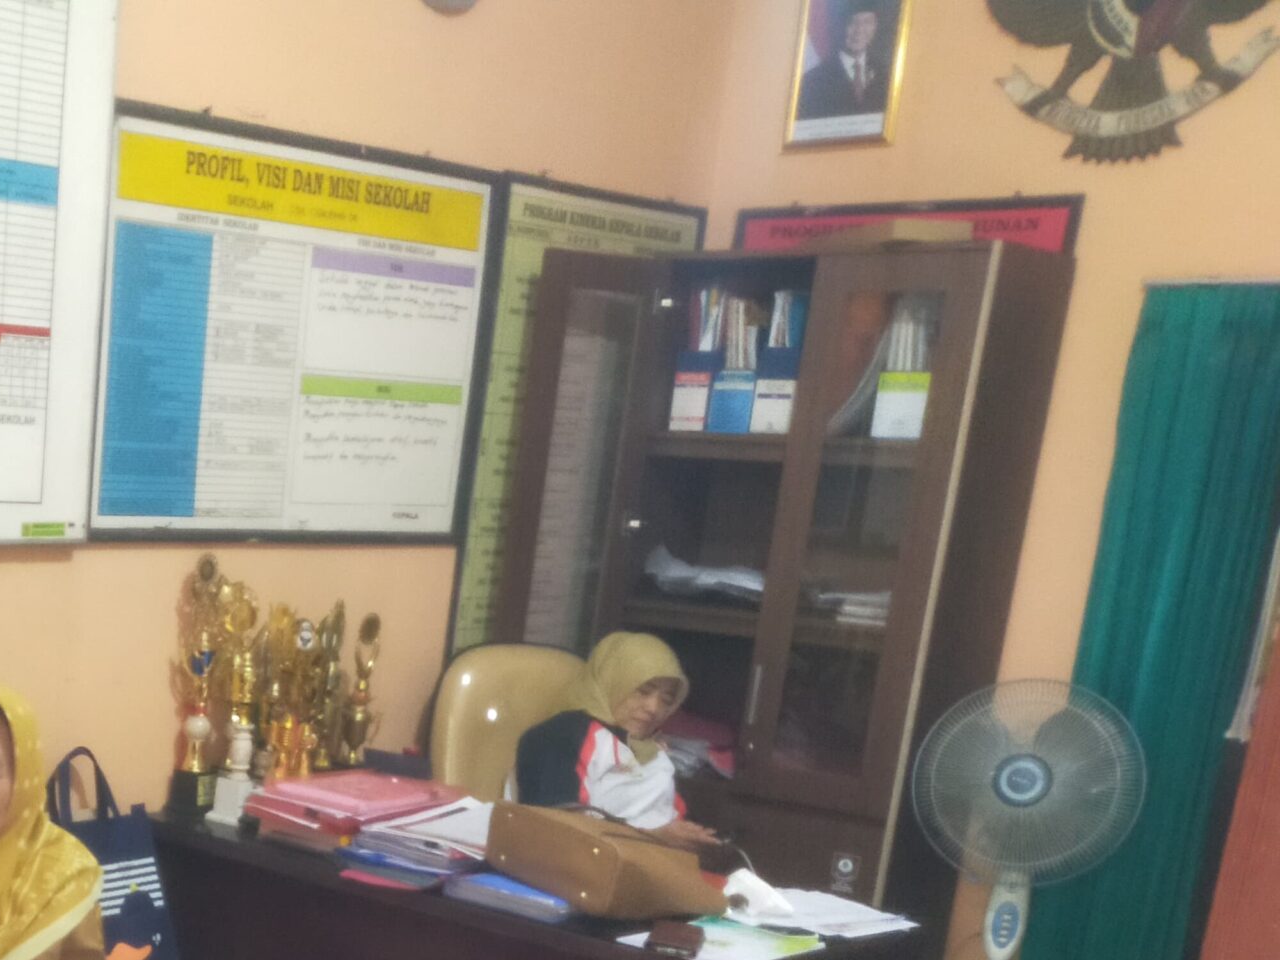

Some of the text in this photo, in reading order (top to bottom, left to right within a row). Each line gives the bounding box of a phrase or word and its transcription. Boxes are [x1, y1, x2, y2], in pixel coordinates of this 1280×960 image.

[186, 151, 249, 187] PROFIL,
[256, 161, 287, 190] VISI
[292, 168, 324, 196] DAN
[329, 175, 360, 203] MISI
[365, 182, 431, 214] SEKOLAH
[227, 193, 274, 213] SEKOLAH
